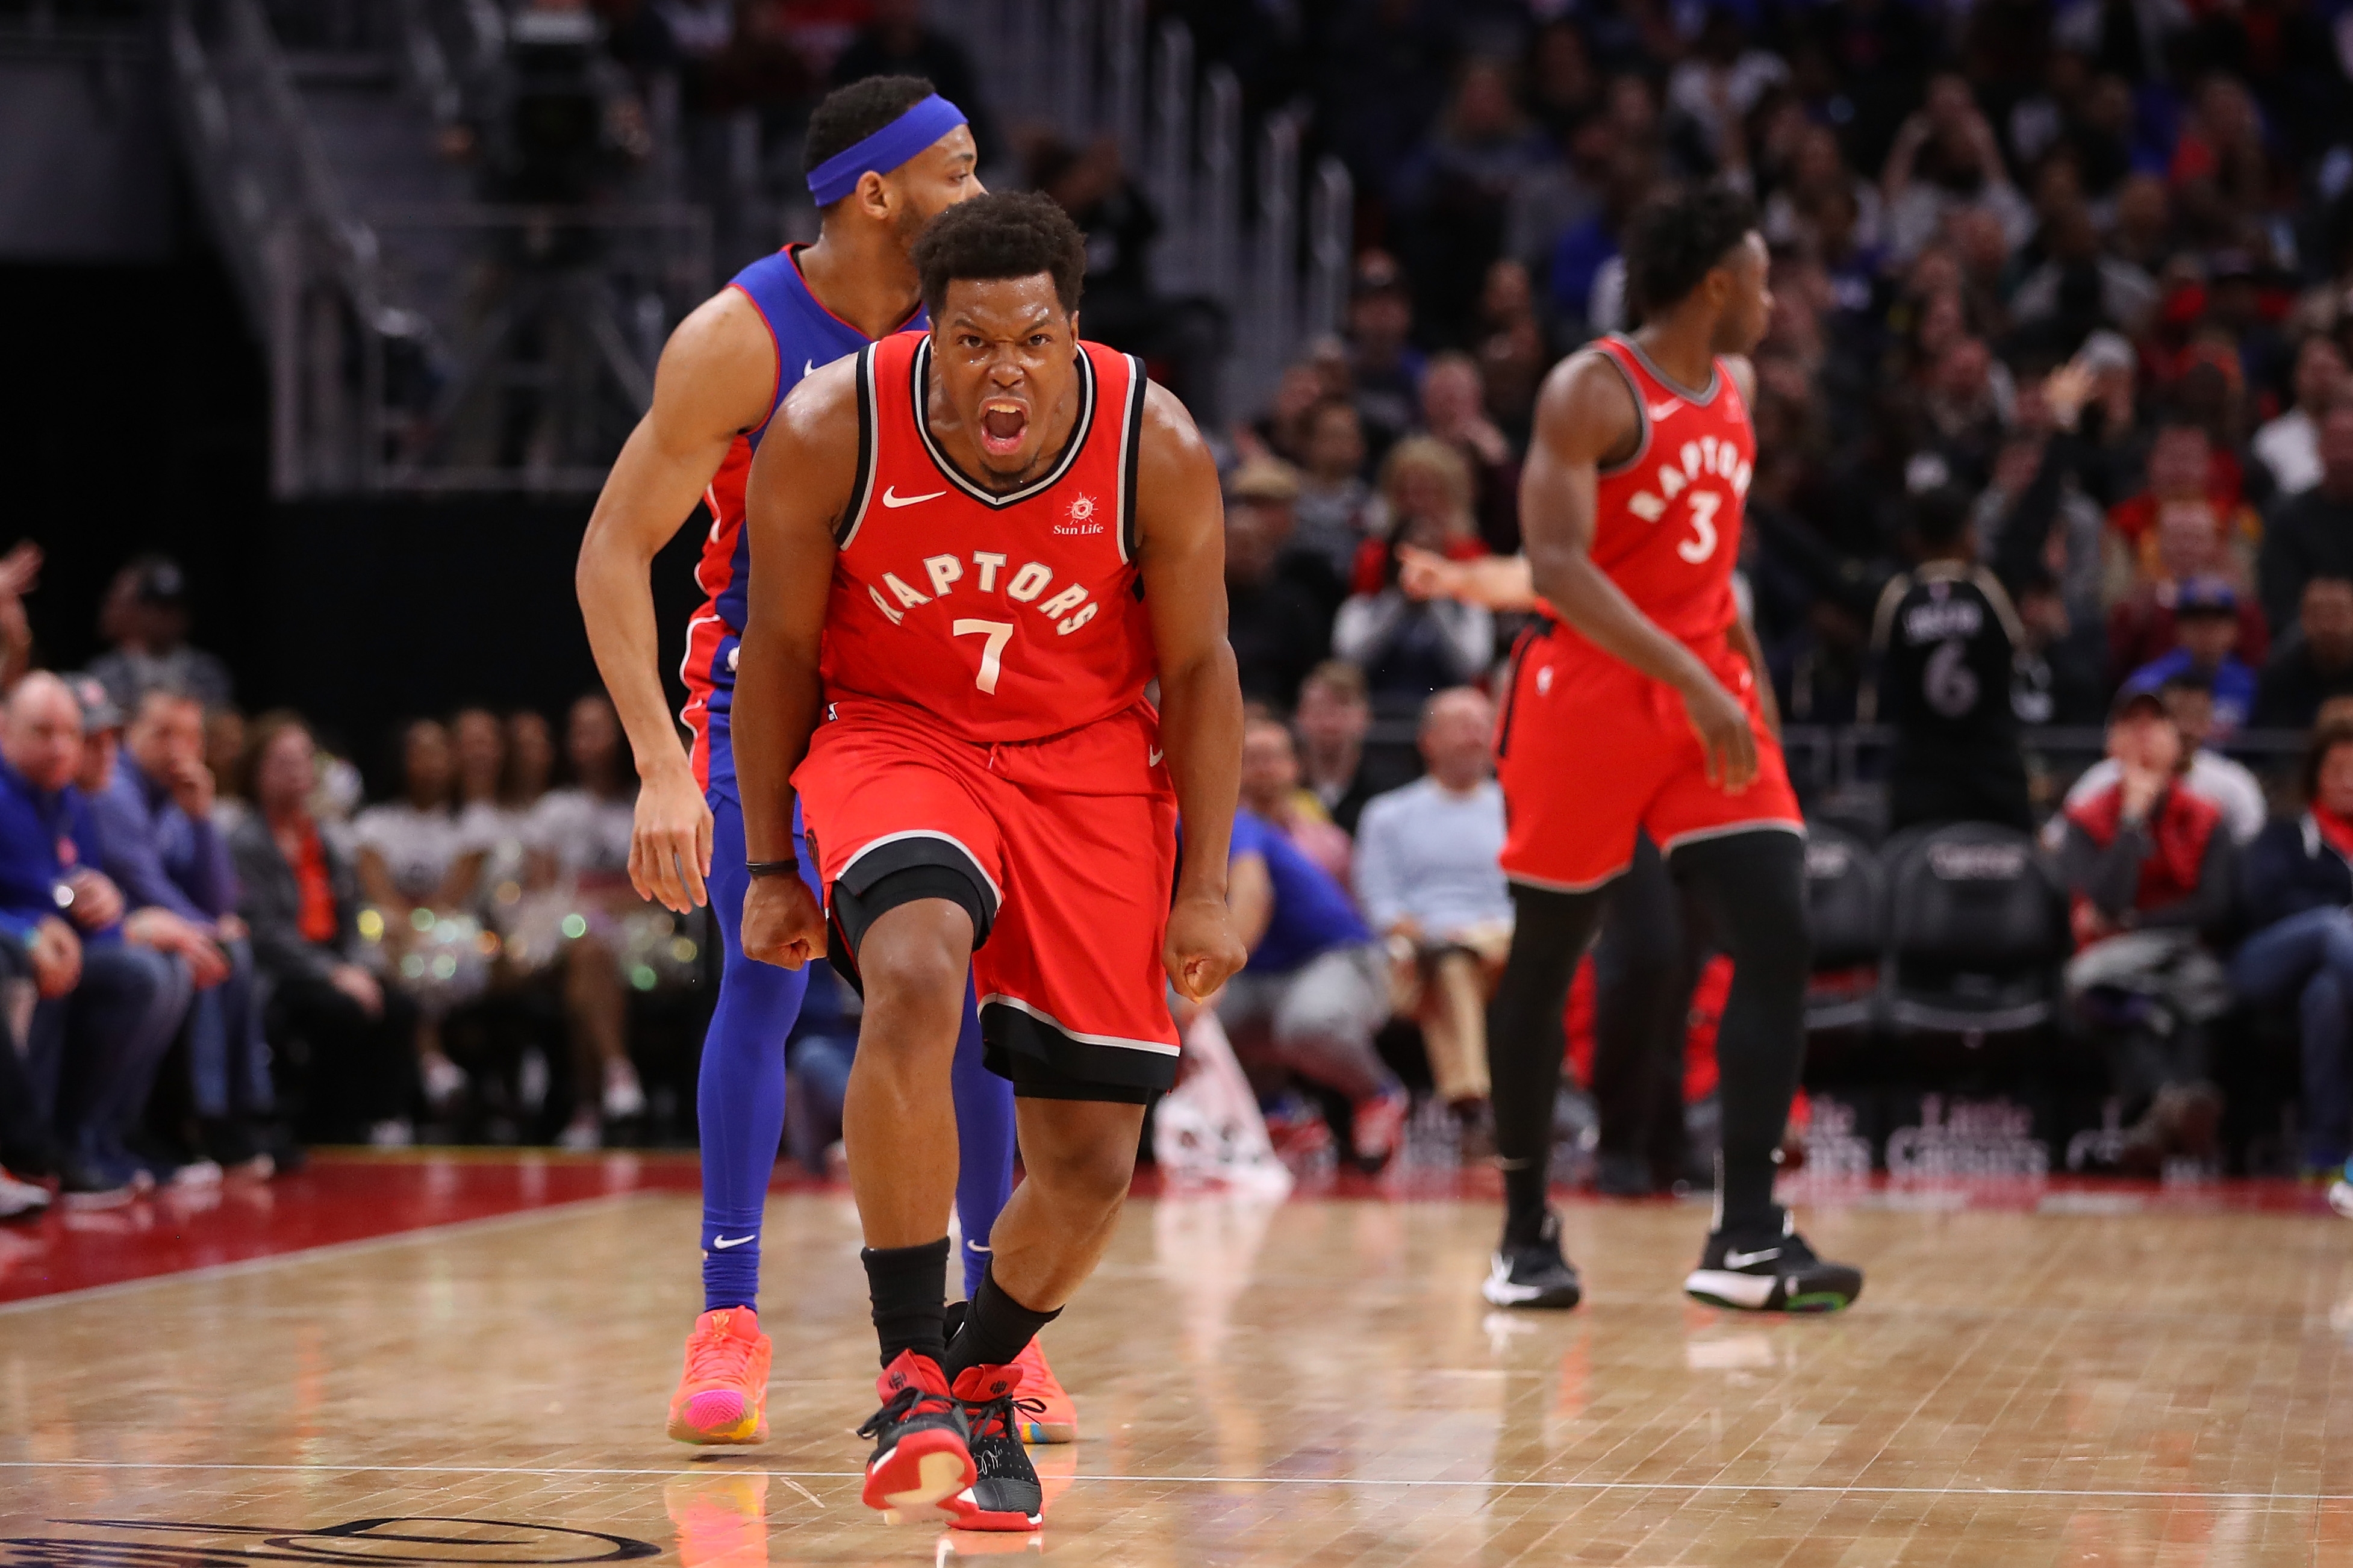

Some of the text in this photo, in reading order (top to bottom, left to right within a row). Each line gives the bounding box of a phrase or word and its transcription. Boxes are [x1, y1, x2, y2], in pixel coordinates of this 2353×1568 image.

[1053, 523, 1104, 535] Sun Life
[1678, 490, 1722, 564] 3
[868, 550, 1099, 636] RAPTORS
[953, 618, 1014, 695] 7
[1925, 642, 1979, 715] 6
